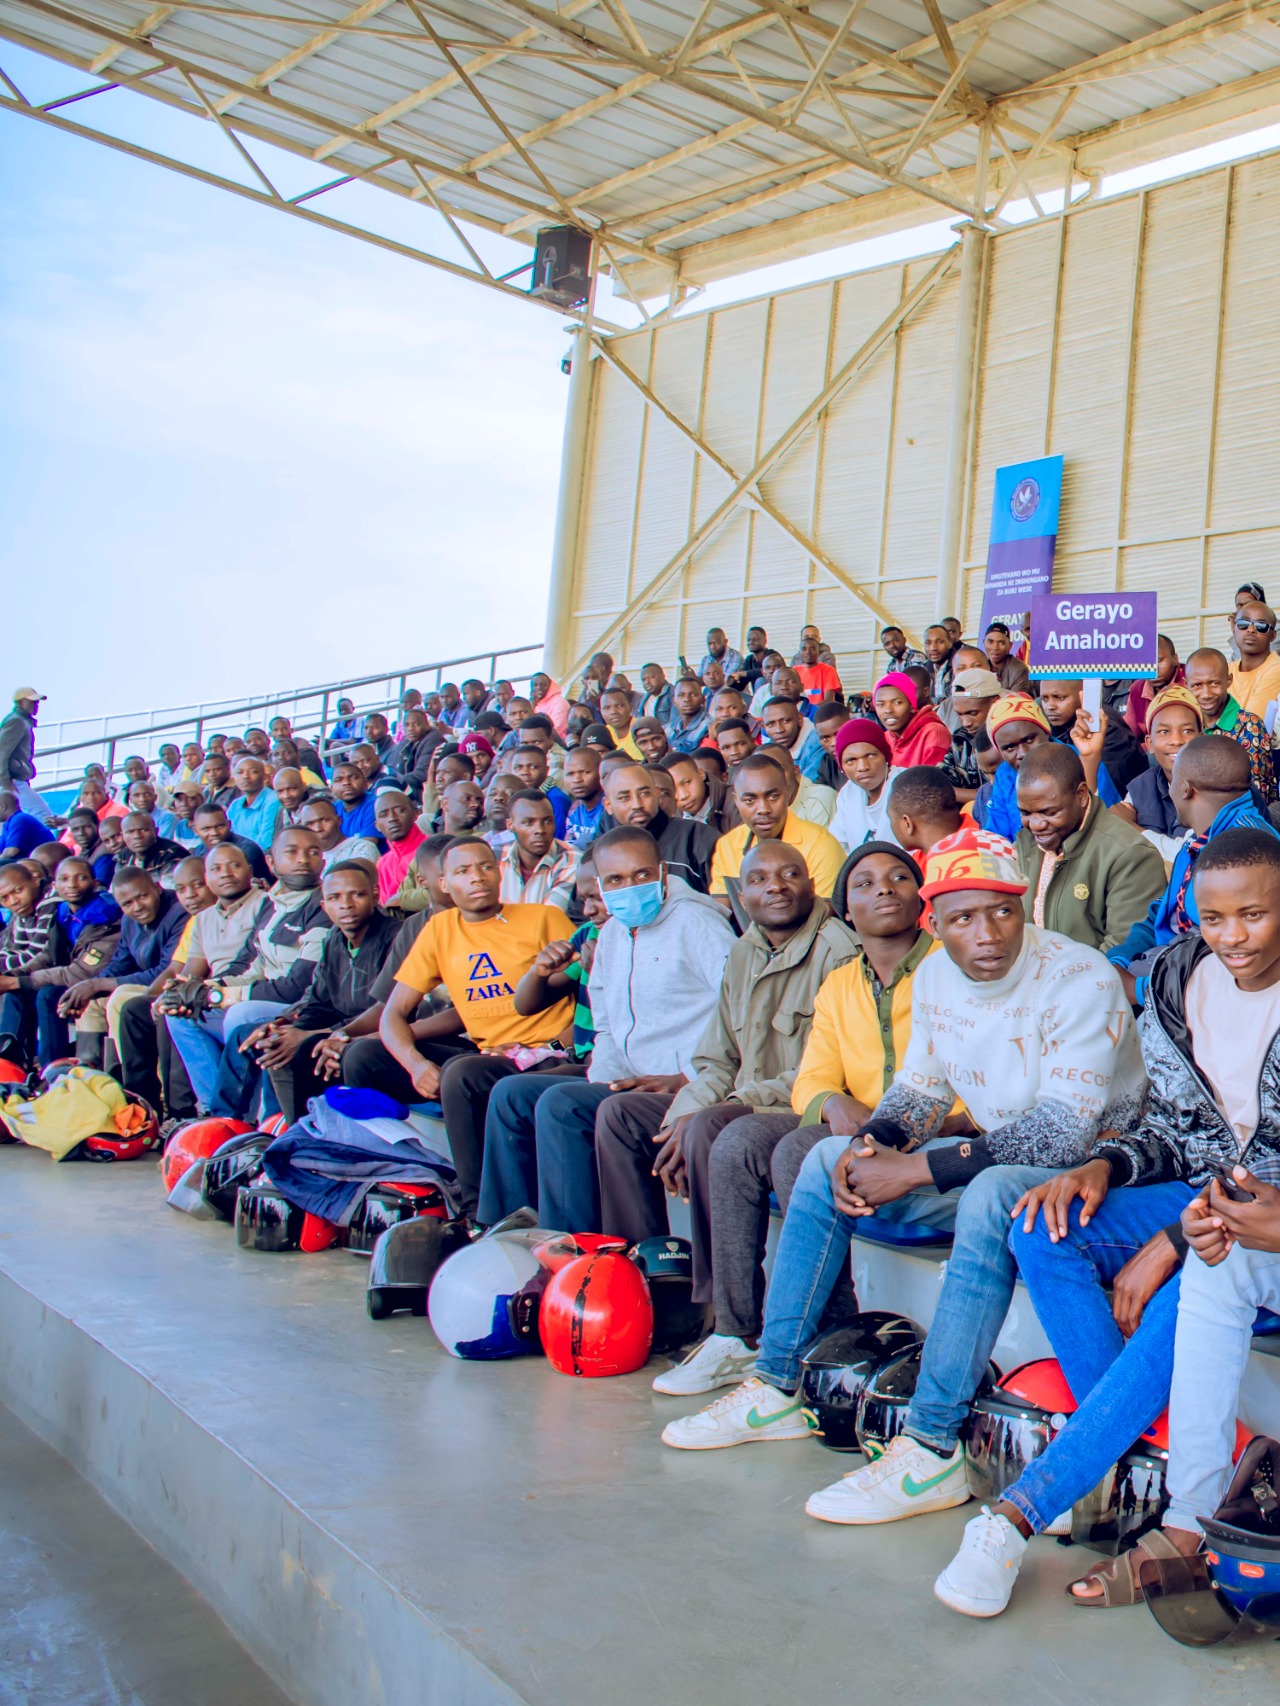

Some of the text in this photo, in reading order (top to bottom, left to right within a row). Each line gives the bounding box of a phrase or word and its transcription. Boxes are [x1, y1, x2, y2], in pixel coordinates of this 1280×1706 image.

[1056, 601, 1133, 624] Gerayo
[1045, 629, 1144, 651] Amahoro
[465, 982, 516, 1002] ZARA
